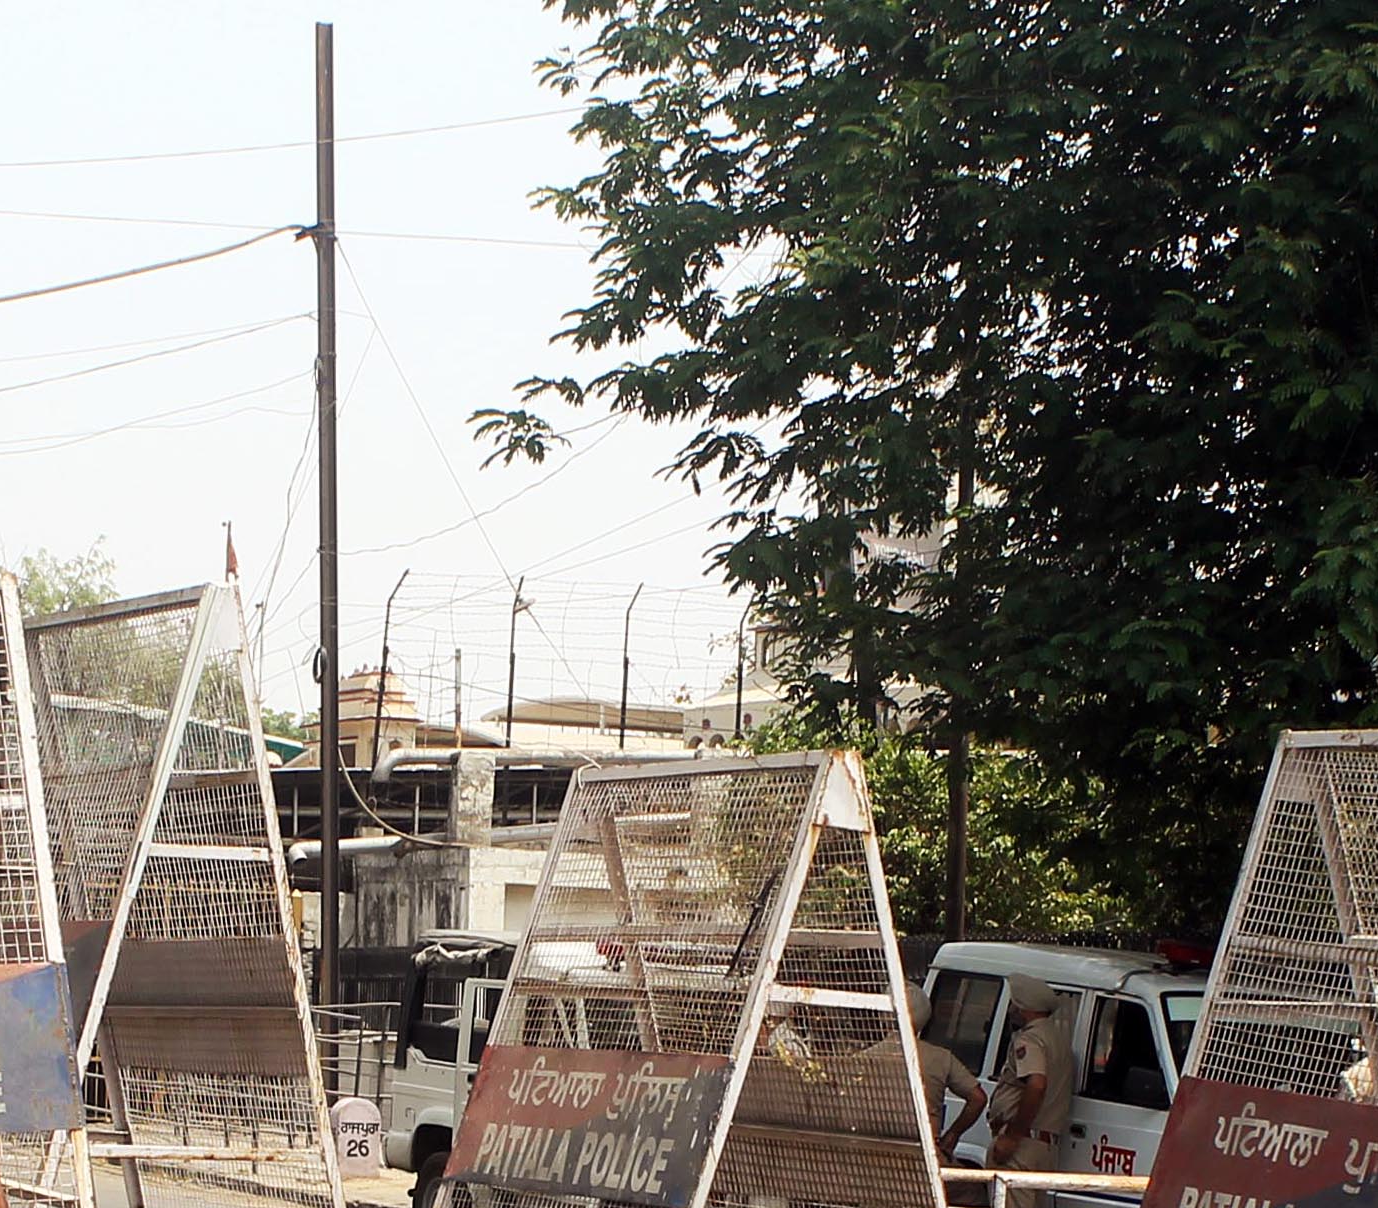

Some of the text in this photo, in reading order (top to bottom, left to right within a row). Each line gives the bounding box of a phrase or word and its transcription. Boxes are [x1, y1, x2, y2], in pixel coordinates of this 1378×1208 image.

[508, 1055, 606, 1109] ਪਟਿਆਲਾ
[347, 1139, 369, 1157] 26
[472, 1122, 674, 1195] PATIALA POLICE
[1092, 1134, 1136, 1176] ਪੰਜਾਬ
[1214, 1102, 1329, 1168] ਪਟਿਆਲਾ
